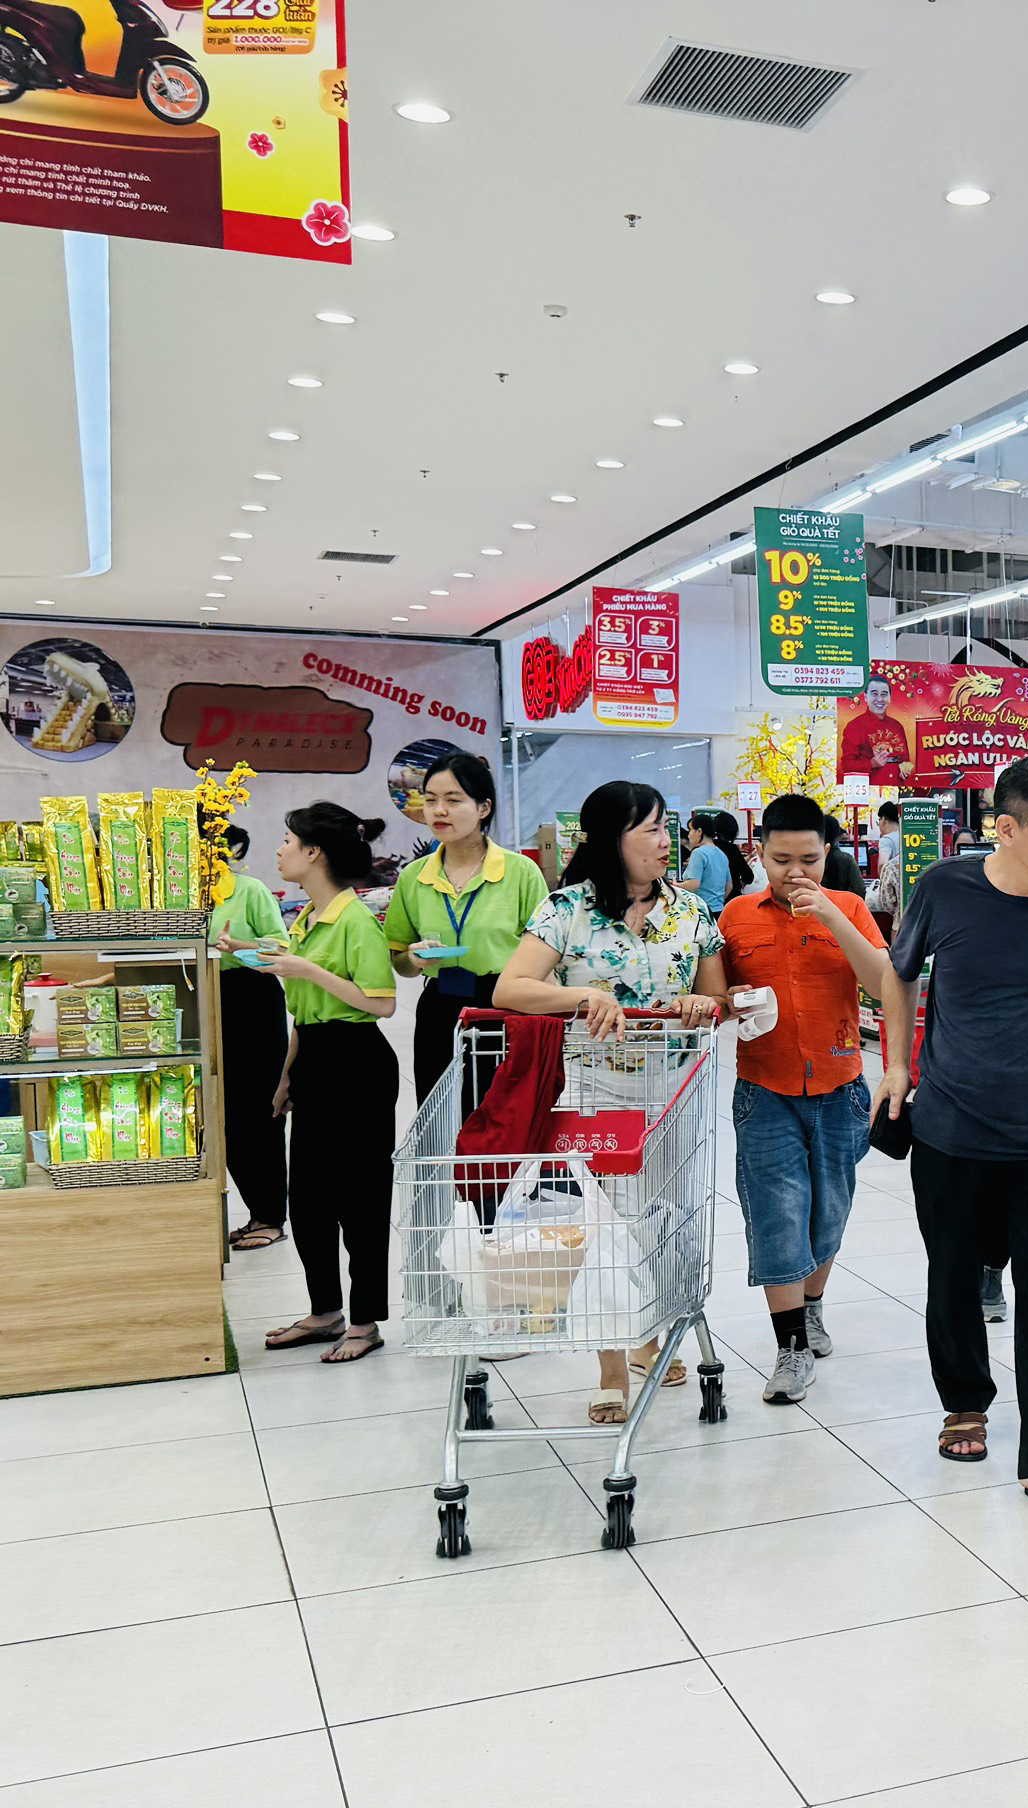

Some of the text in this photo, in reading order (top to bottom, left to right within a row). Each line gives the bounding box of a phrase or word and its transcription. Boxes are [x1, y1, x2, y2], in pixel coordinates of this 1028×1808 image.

[20, 169, 46, 180] mang
[35, 161, 61, 172] mang
[6, 187, 26, 196] xem
[778, 511, 840, 526] CHIẾT KHẤU
[779, 525, 841, 542] GIỎ QUÀ TẾT
[764, 550, 822, 586] 10%
[602, 600, 667, 611] PHIẾU MUA HÀNG
[612, 593, 658, 604] CHIẾT KHẤU
[777, 590, 803, 611] 9%
[770, 614, 812, 636] 8.5%
[780, 640, 804, 661] 8%
[302, 652, 487, 736] comming soon
[941, 706, 960, 724] Tết
[963, 705, 997, 728] Rồng
[921, 730, 970, 749] RƯỚC
[972, 730, 1005, 750] LỘC
[933, 748, 981, 768] NGÀN
[748, 791, 758, 801] 27
[855, 785, 867, 796] 25
[903, 834, 927, 848] 10%
